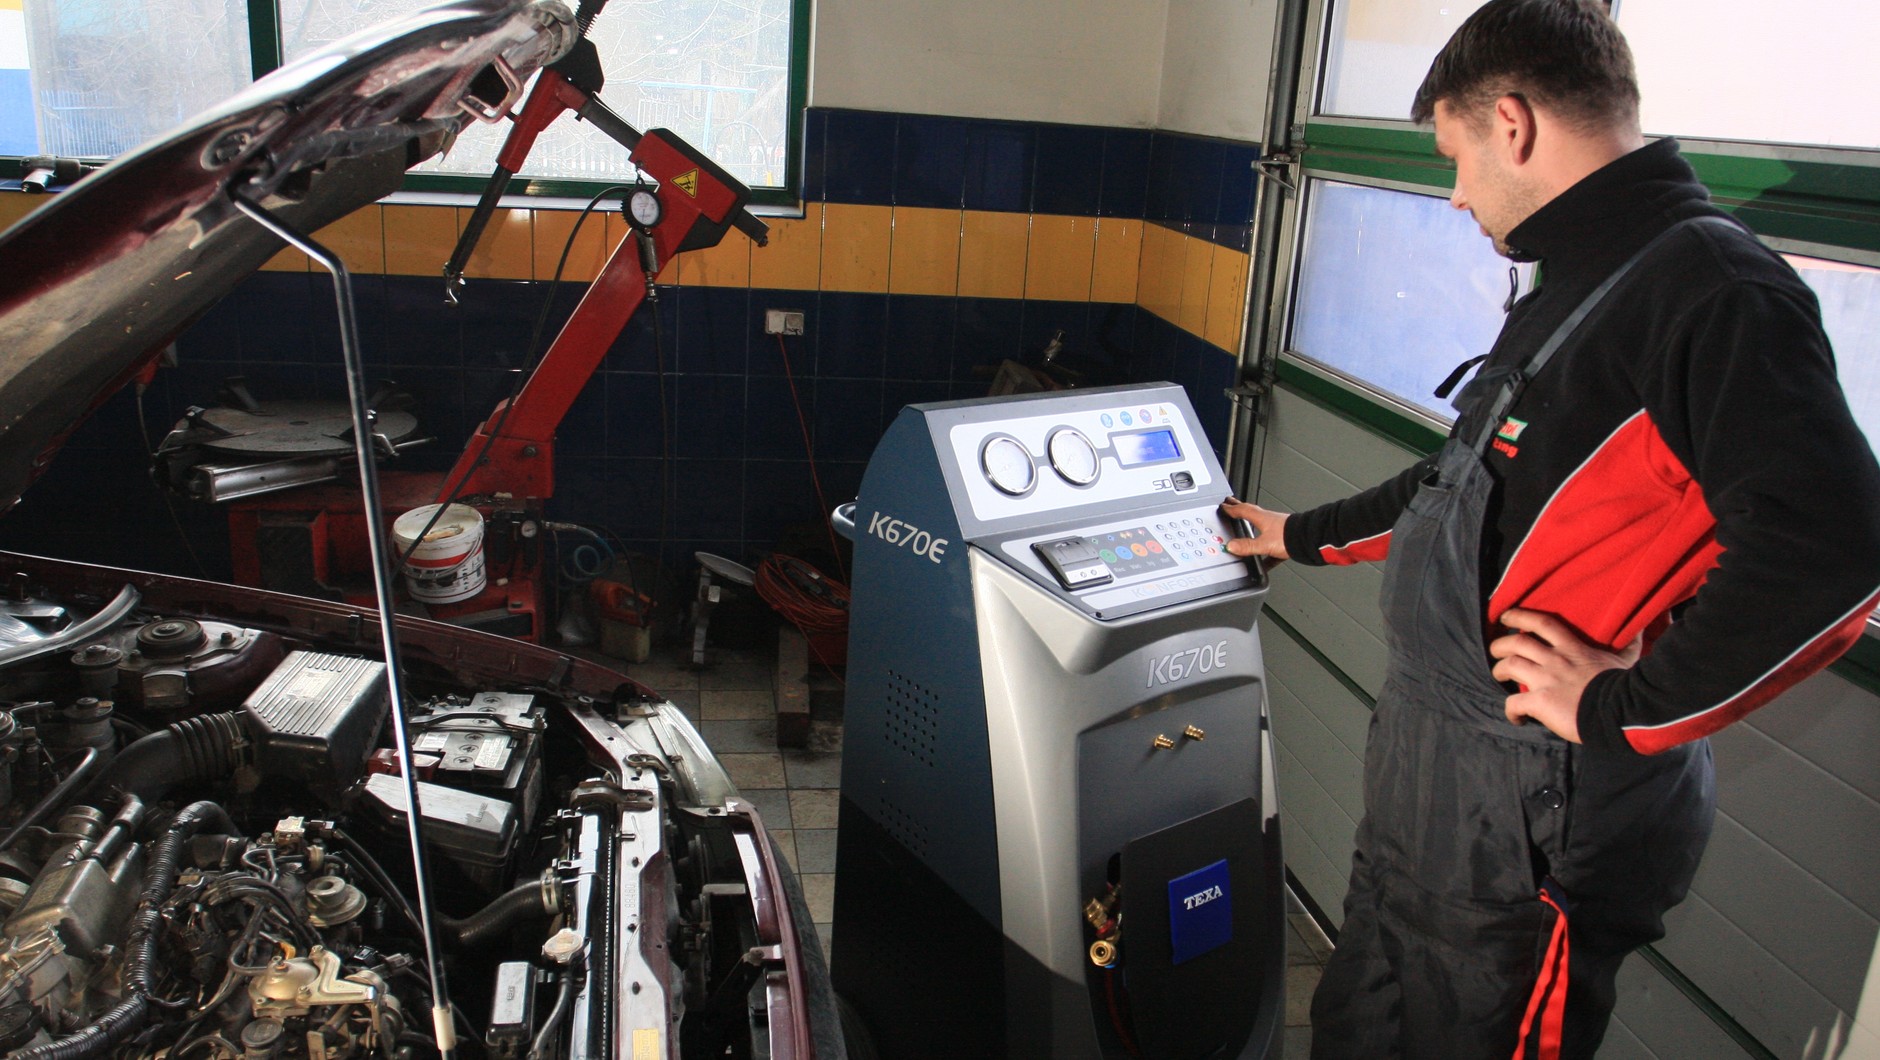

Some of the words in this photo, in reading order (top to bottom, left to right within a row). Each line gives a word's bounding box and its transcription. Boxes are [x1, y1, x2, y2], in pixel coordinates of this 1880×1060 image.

[868, 511, 949, 564] K670E
[1146, 639, 1228, 689] K670E
[1183, 885, 1223, 910] TEXA
